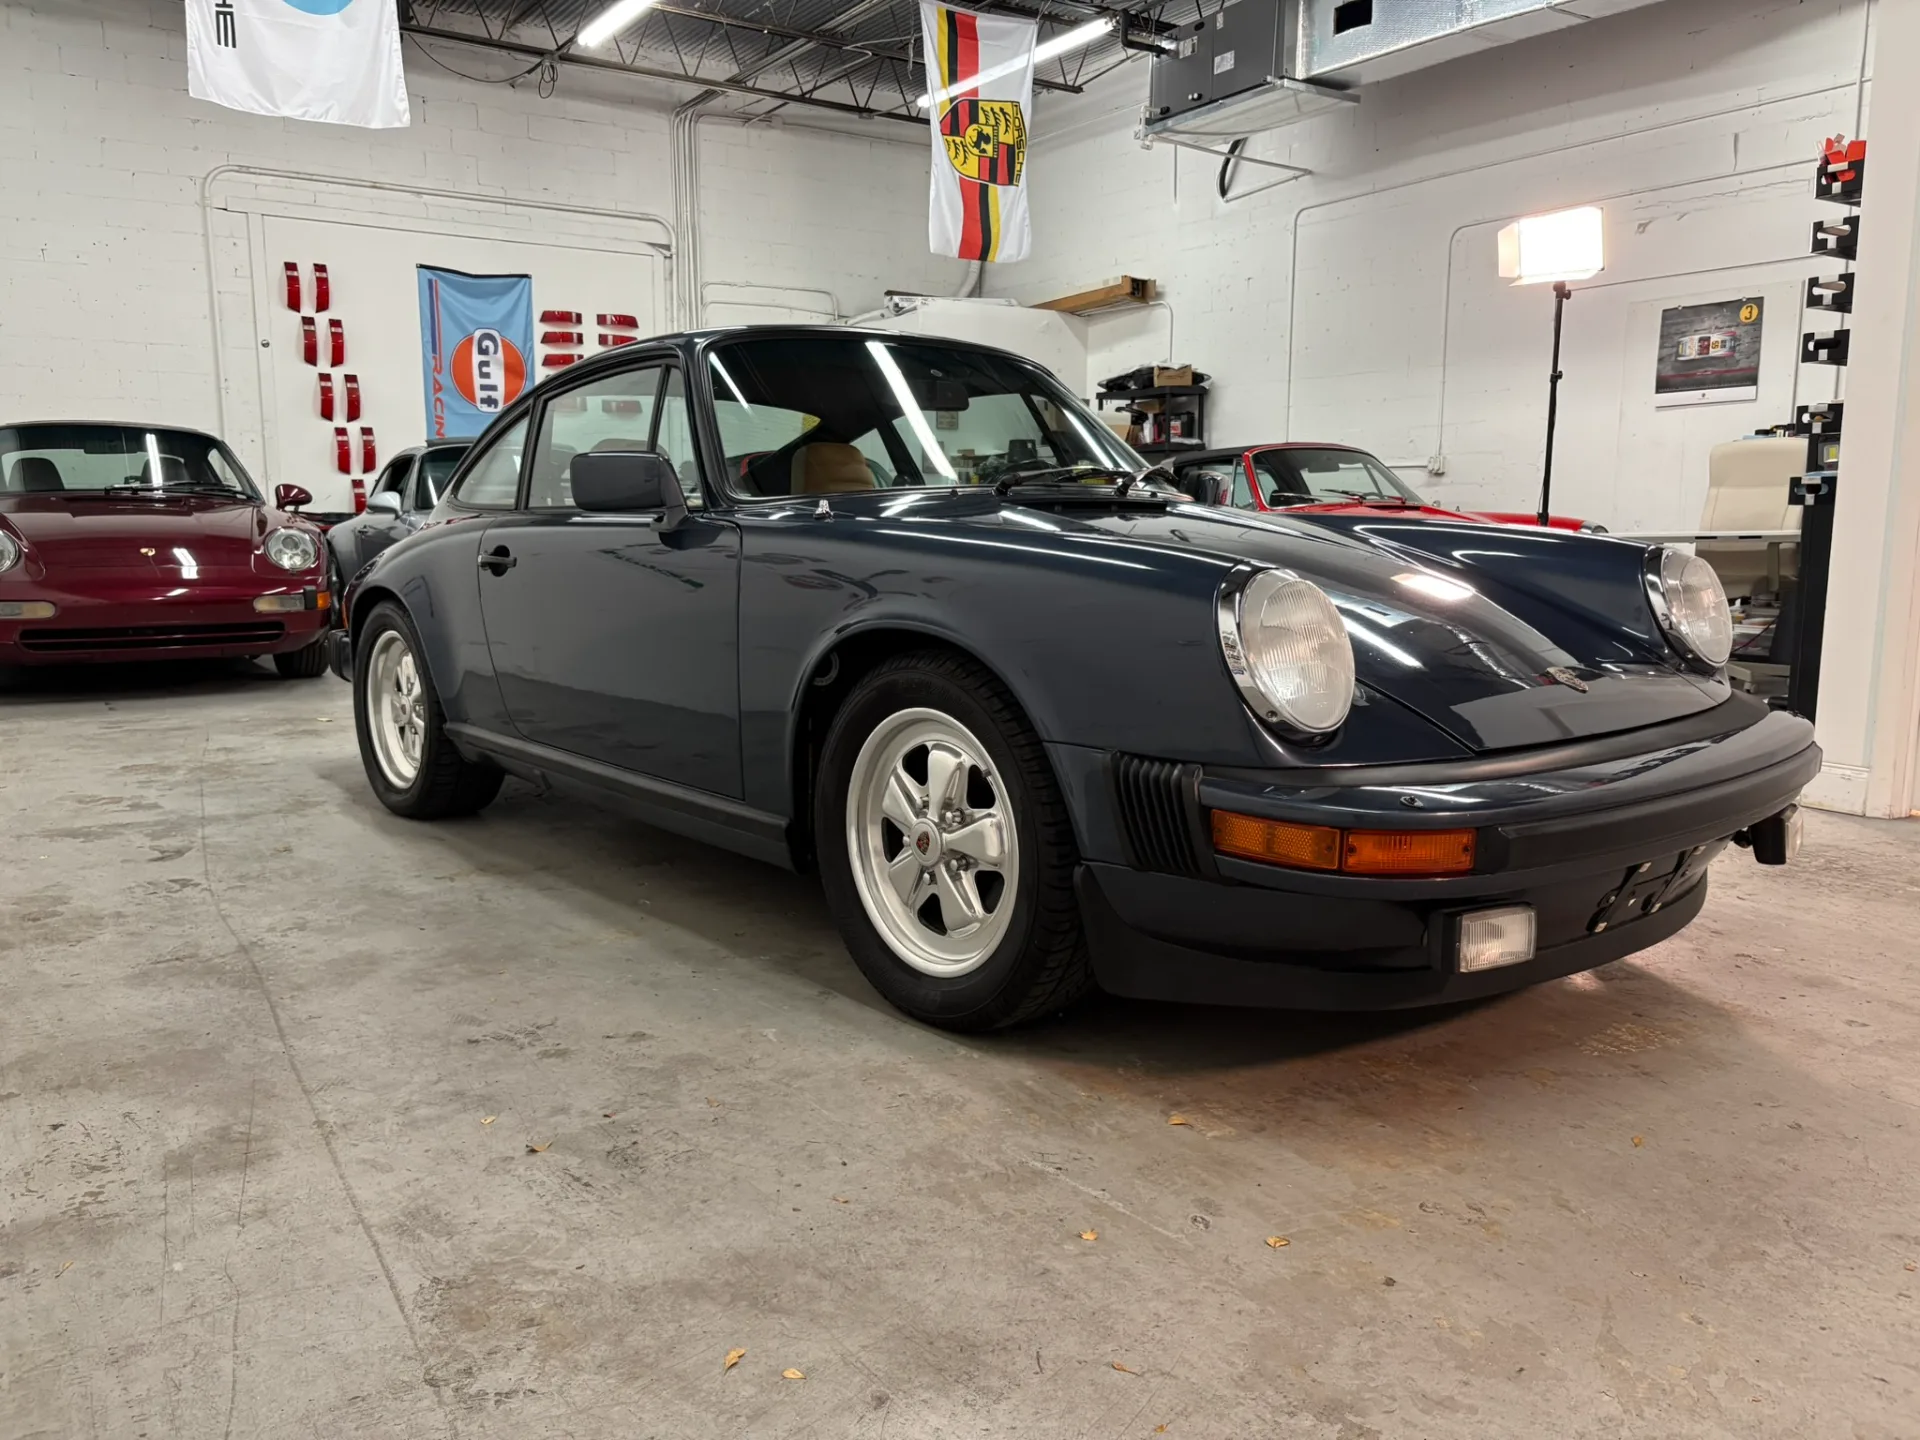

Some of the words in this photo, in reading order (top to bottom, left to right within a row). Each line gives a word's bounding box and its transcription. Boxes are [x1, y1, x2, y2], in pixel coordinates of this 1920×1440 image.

[1013, 104, 1025, 183] PORSCHE
[1744, 305, 1753, 320] 3
[432, 355, 446, 439] RACIN
[478, 332, 499, 409] Gulf
